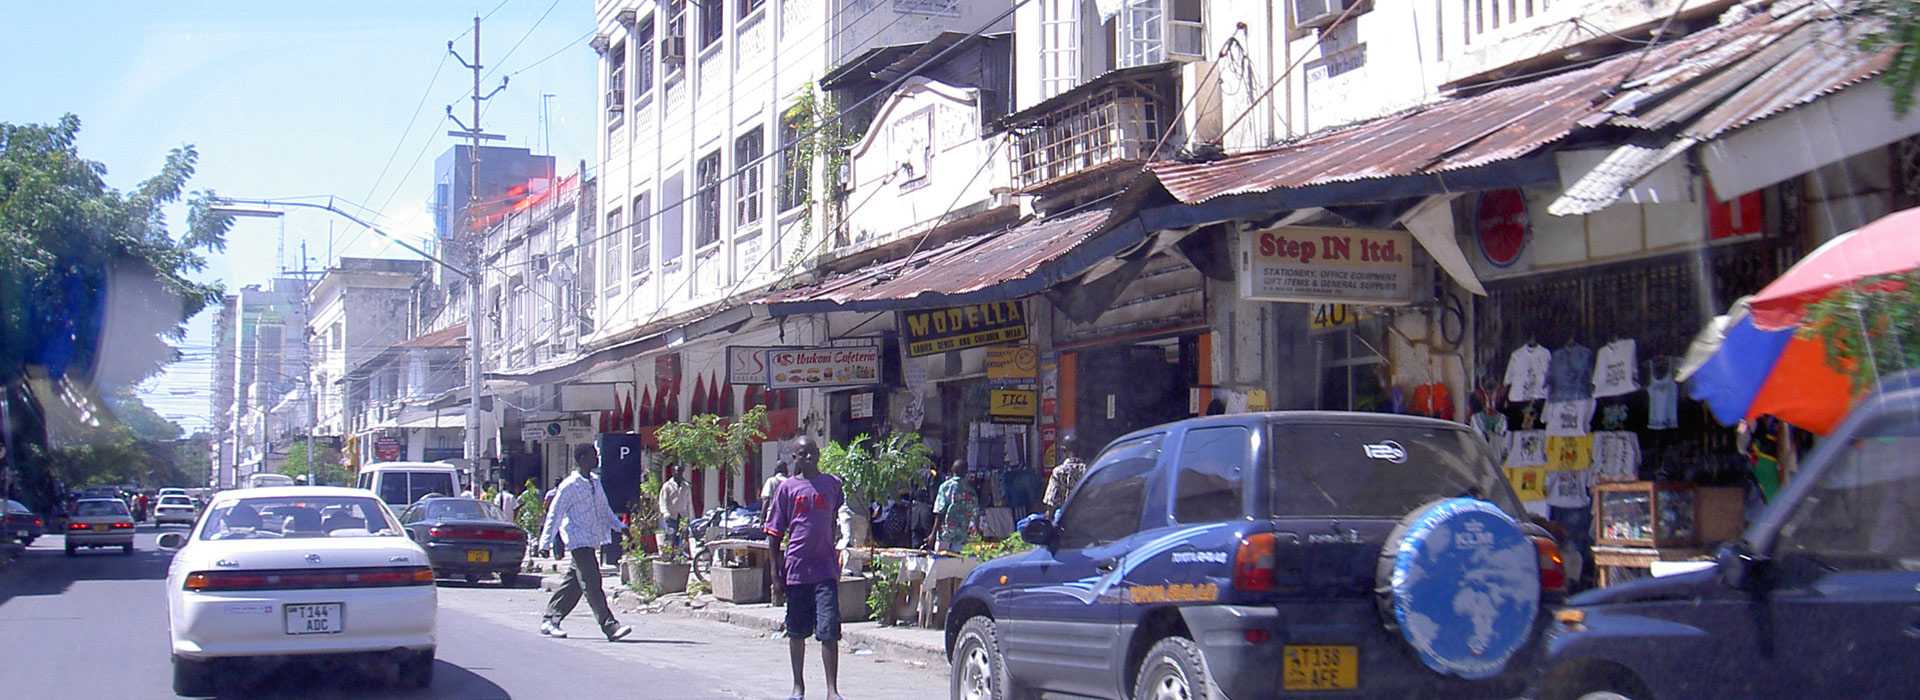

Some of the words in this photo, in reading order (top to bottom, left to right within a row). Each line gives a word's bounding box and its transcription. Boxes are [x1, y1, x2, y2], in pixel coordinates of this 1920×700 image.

[1259, 232, 1317, 264] Step
[1321, 235, 1351, 261] IN
[1360, 238, 1403, 263] ltd.
[1263, 276, 1281, 285] GIFT
[1283, 278, 1310, 287] ITEMS
[1320, 280, 1357, 289] GENERAL
[1320, 270, 1348, 279] OFFICE
[1351, 271, 1397, 281] EQUIPMENT
[907, 300, 1020, 337] MODELLA
[834, 350, 876, 364] Cafeteria
[619, 446, 631, 460] P
[1455, 532, 1495, 550] KLM
[306, 619, 328, 631] ADC
[1311, 668, 1340, 689] AFE
